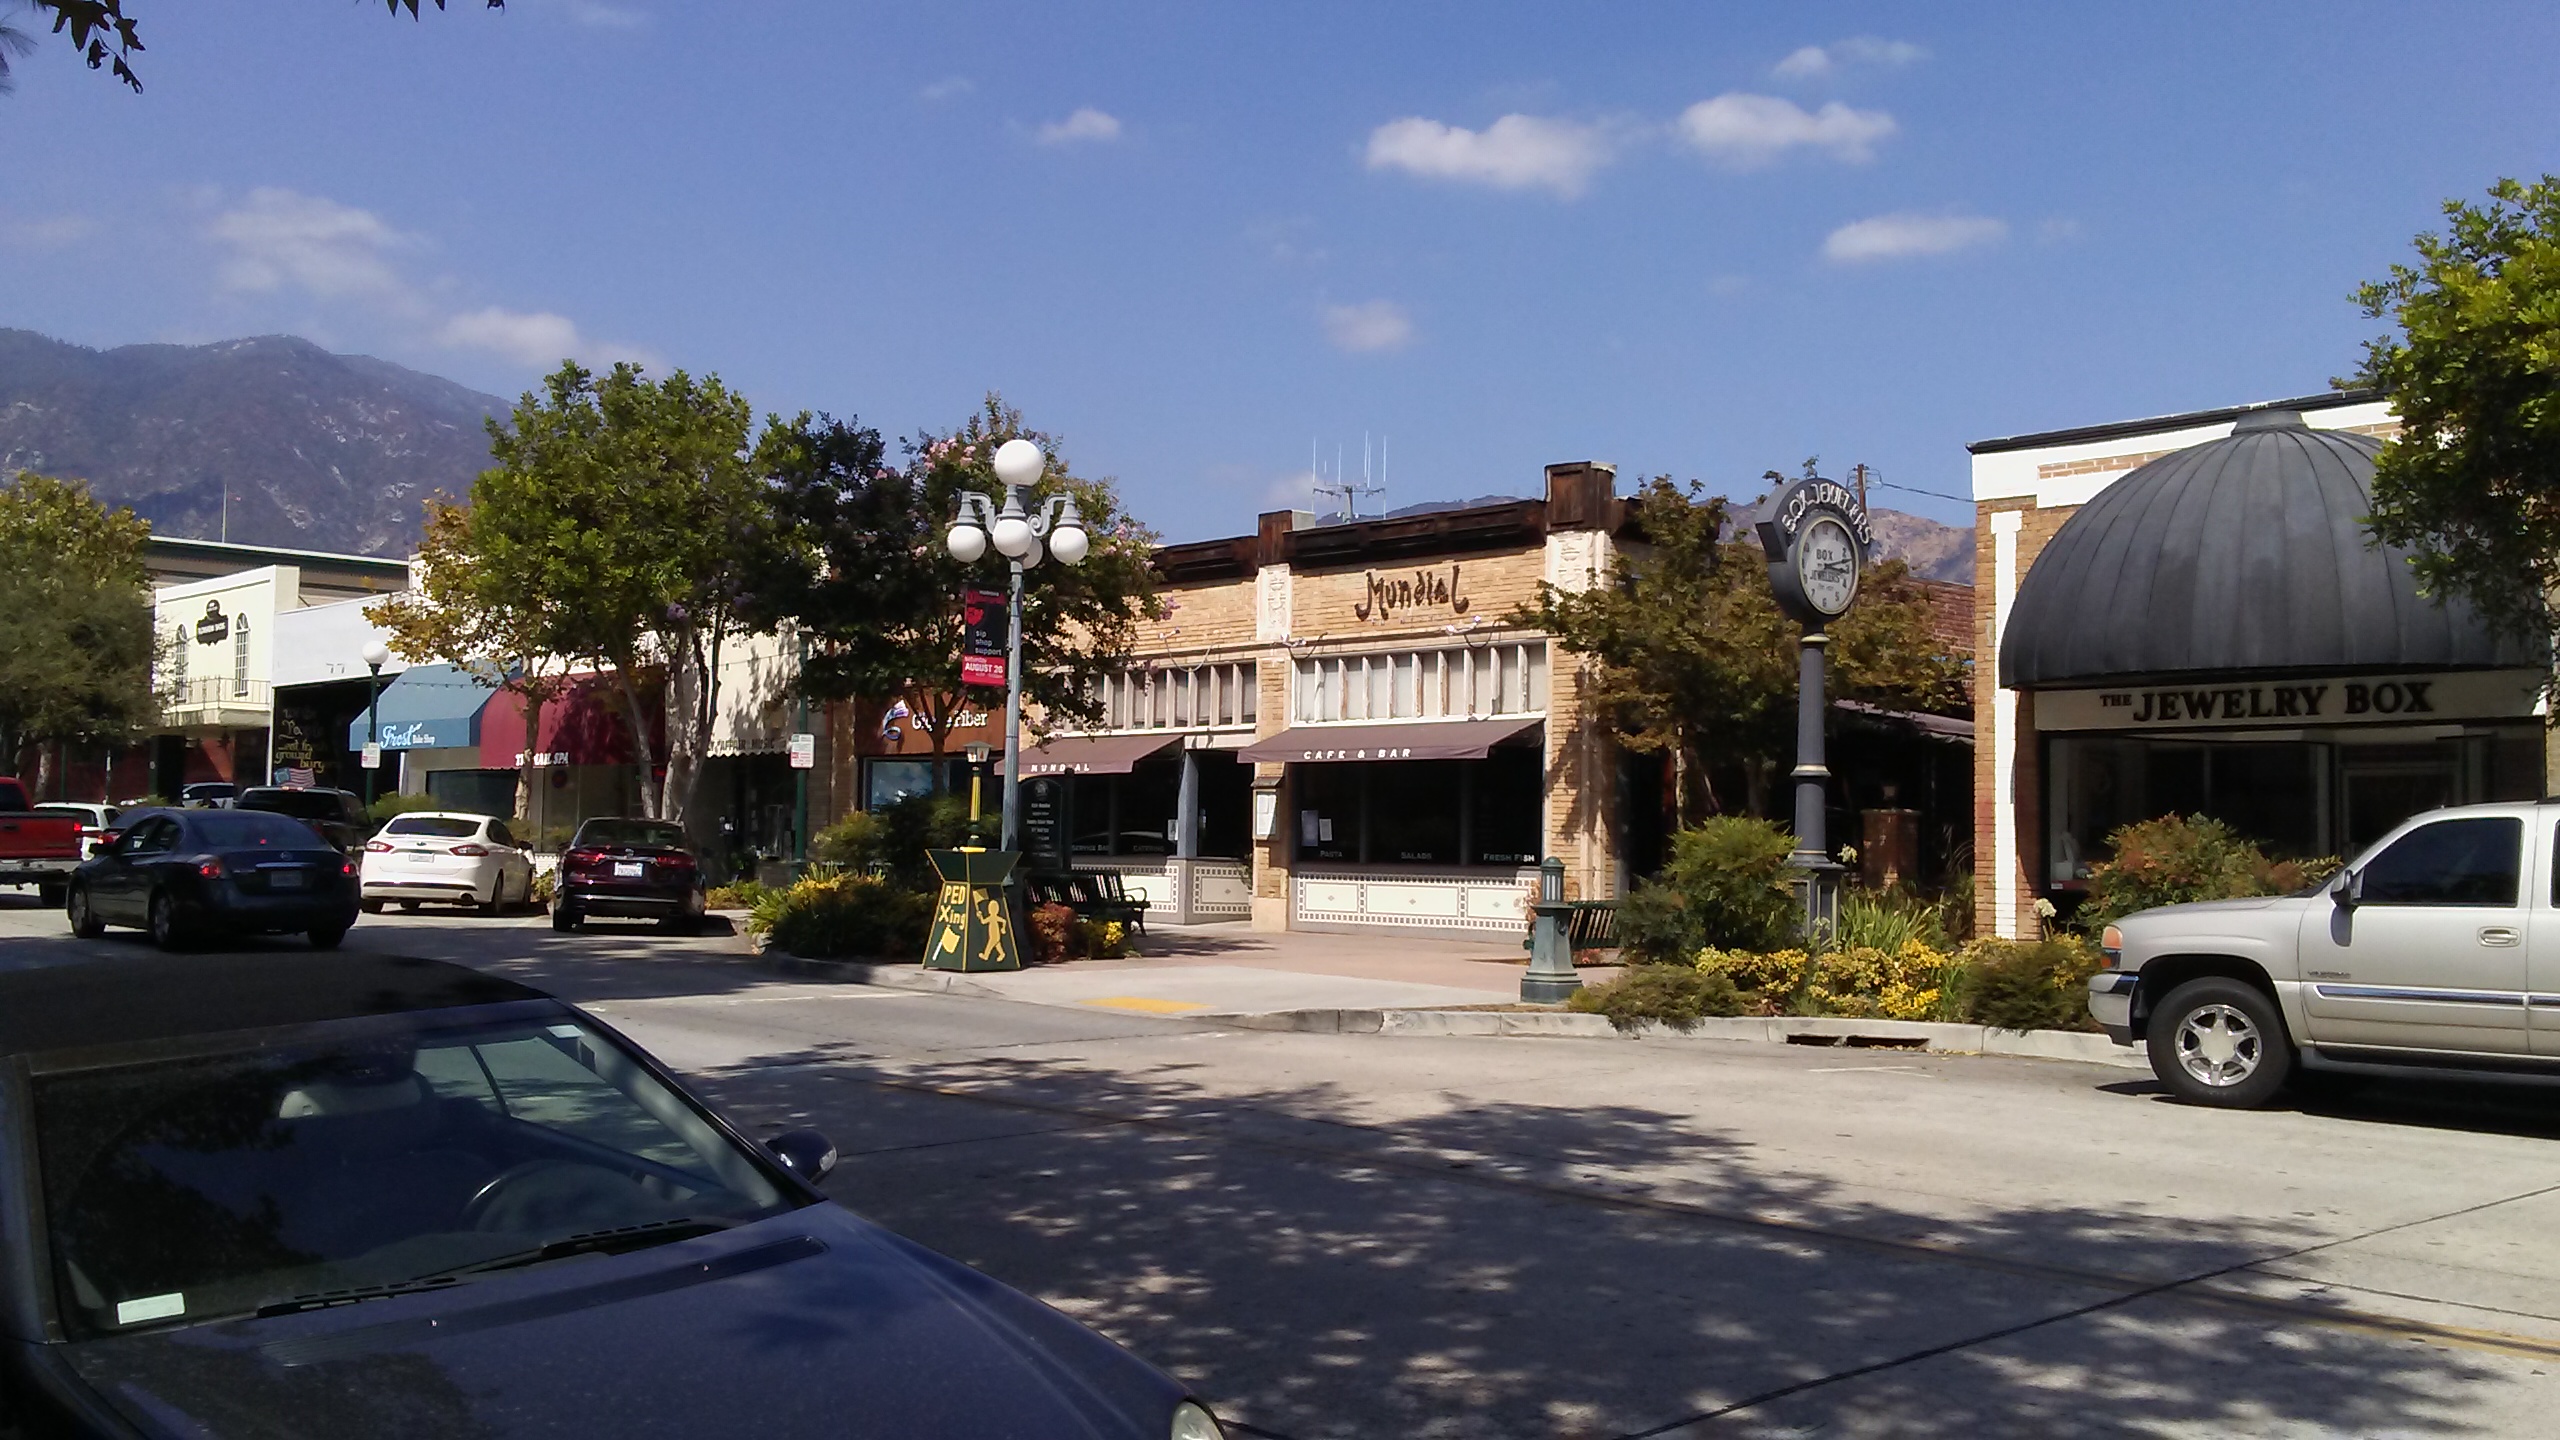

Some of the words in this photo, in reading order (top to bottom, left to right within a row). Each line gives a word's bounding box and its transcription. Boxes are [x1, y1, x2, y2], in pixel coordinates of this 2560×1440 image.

[1807, 483, 1873, 544] JEWELERS
[1816, 548, 1834, 561] BOX
[1354, 564, 1470, 622] Mundial
[975, 639, 993, 647] shop
[974, 647, 1002, 656] support
[965, 662, 993, 673] AUGUST
[2100, 694, 2132, 707] THE
[2133, 686, 2328, 721] JEWELRY
[2344, 682, 2434, 714] BOX
[380, 722, 423, 748] Frost
[553, 752, 569, 765] SPA
[1303, 750, 1347, 760] CAFE
[1357, 749, 1366, 759] &
[1378, 748, 1411, 758] BAR
[1483, 853, 1512, 861] FRESH
[944, 885, 966, 905] PED
[938, 905, 966, 930] Xing
